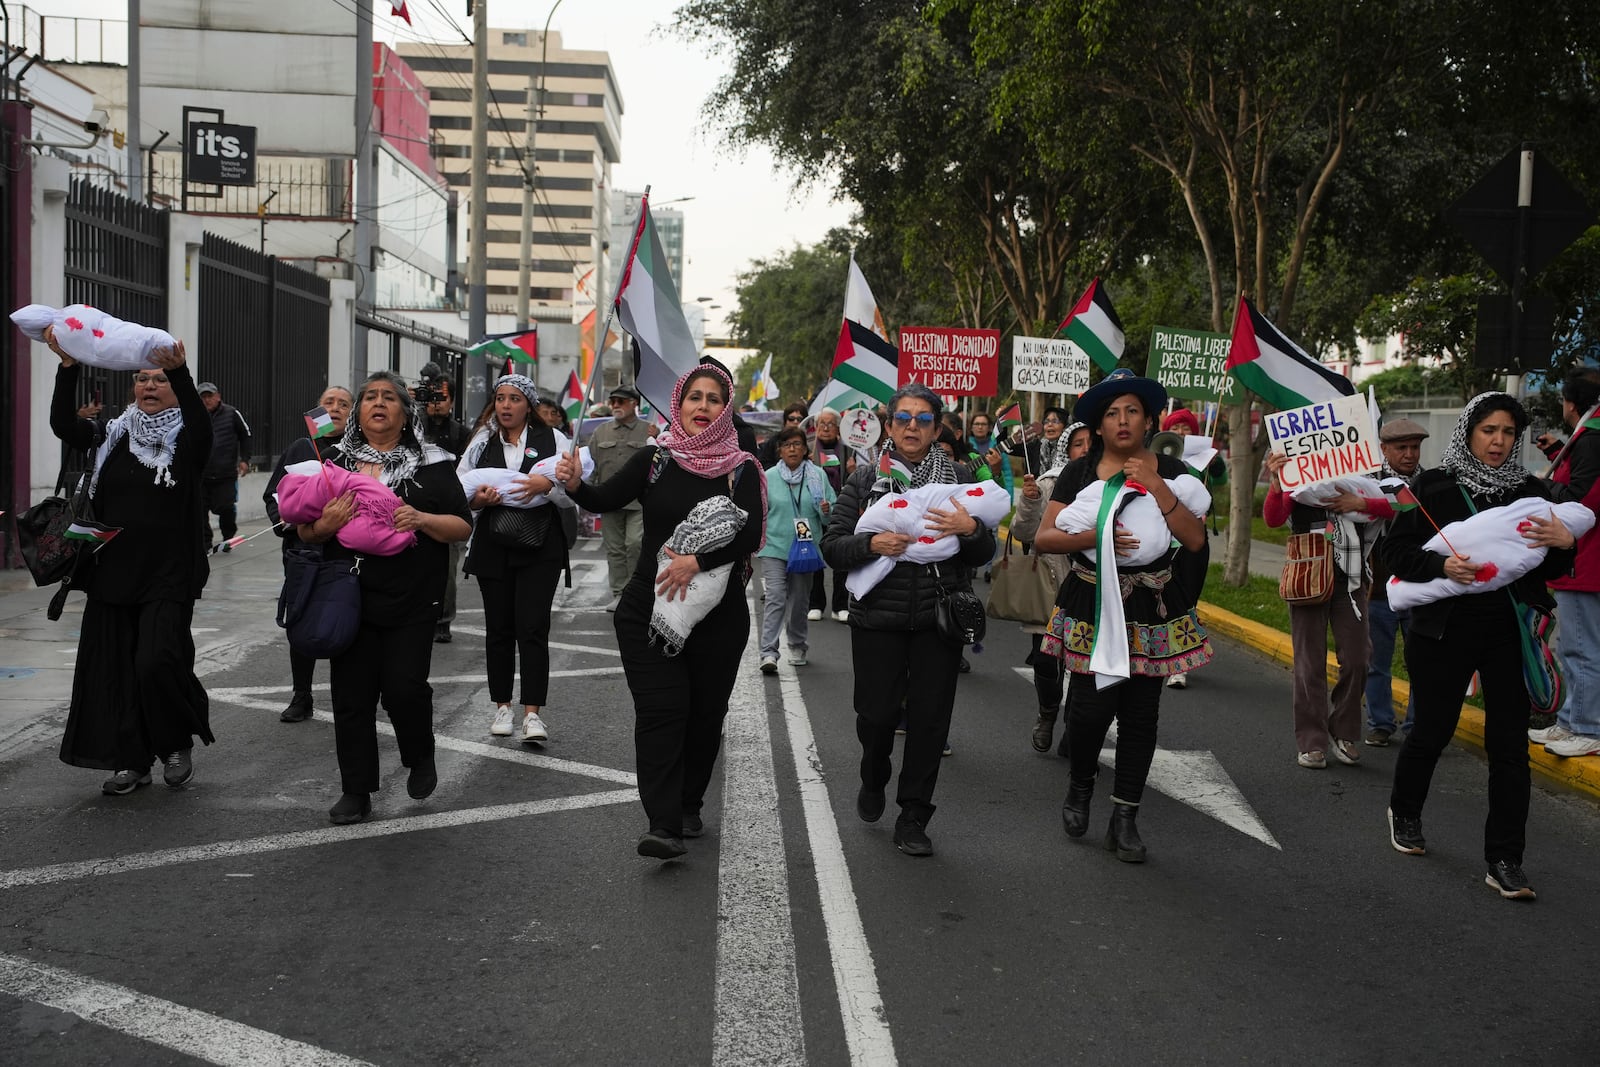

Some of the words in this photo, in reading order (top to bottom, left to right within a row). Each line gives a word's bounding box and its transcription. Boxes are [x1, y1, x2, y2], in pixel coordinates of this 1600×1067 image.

[1051, 343, 1073, 357] NIÑA
[1160, 352, 1193, 370] DESDE
[1194, 357, 1207, 369] EL
[1047, 369, 1073, 386] EXIGE
[1157, 370, 1191, 388] HASTA
[1193, 375, 1206, 387] EL
[1207, 375, 1234, 396] MAR
[1269, 403, 1344, 440] ISRAEL
[1283, 426, 1359, 458] ESTADO
[1279, 440, 1382, 488] CRIMINAL
